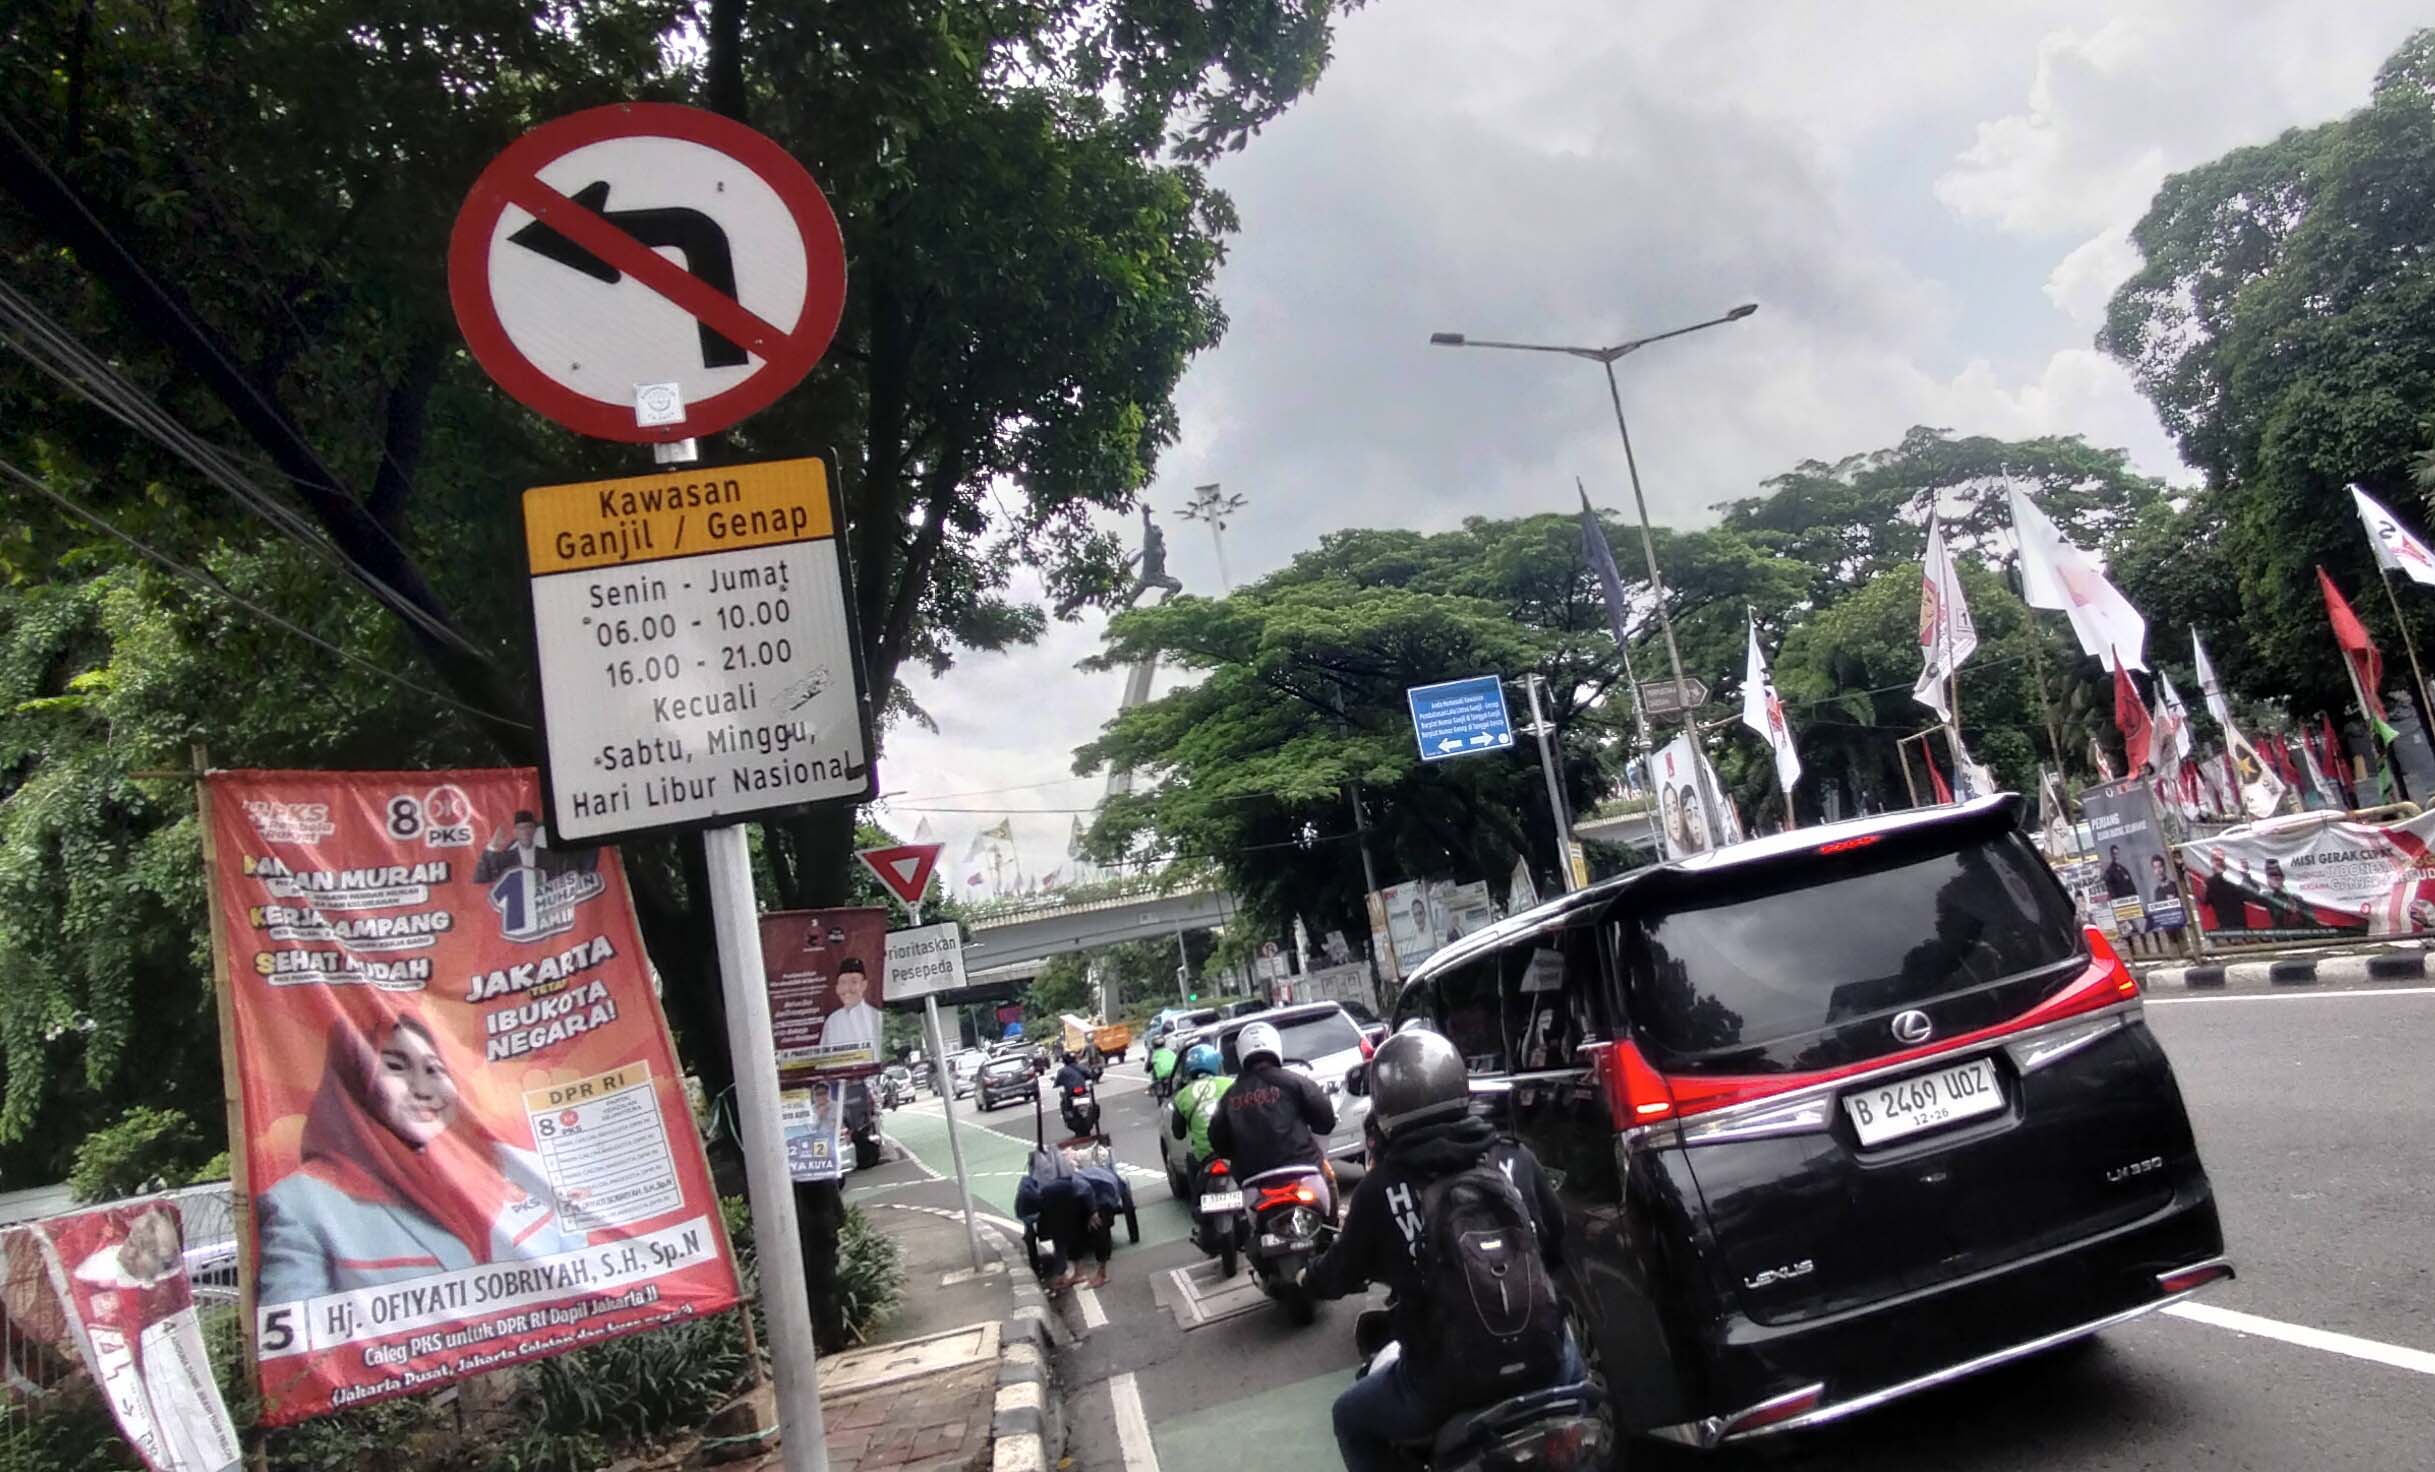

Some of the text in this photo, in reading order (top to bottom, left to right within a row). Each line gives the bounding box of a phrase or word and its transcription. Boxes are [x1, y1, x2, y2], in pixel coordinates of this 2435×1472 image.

[600, 479, 741, 518] Kawasan
[556, 505, 809, 561] Ganjil / Genap
[590, 576, 667, 609] Senin
[709, 560, 790, 594] Jumat
[597, 613, 678, 648] 06.00
[716, 598, 791, 631] 10.00
[606, 653, 681, 688] 16.00
[721, 638, 792, 671] 21.00
[653, 681, 757, 723] Kecuali
[604, 721, 817, 771] Sabtu, Minggu,
[572, 751, 852, 819] Hari Libur Nasional
[391, 798, 421, 836] 8
[429, 829, 471, 843] PKS
[341, 861, 448, 890] MURAH
[2291, 854, 2316, 868] MISI
[2319, 850, 2360, 865] GERAK
[249, 905, 330, 929] KERJA
[255, 949, 339, 975] SEHAT
[466, 935, 615, 1003] JAKARTA
[891, 959, 953, 983] Pesepeda
[486, 979, 610, 1034] IBUKOTA
[487, 1000, 618, 1062] NEGARA!
[549, 1073, 626, 1105] DPR RI
[1854, 1066, 1990, 1126] B 2469 UOZ
[538, 1118, 556, 1137] 8
[326, 1229, 700, 1339] Hj. OFIYATI SOBRIYAH, S.H, Sp.N
[1743, 1258, 1815, 1290] LEXUS
[261, 1308, 295, 1351] 5
[364, 1345, 408, 1367] Caleg
[410, 1333, 442, 1357] PKS
[446, 1322, 495, 1348] untuk
[496, 1314, 528, 1335] DPR
[530, 1310, 548, 1328] RI
[550, 1300, 589, 1325] Dapil
[591, 1288, 645, 1316] Jakarta
[457, 1345, 517, 1373] Jakarta
